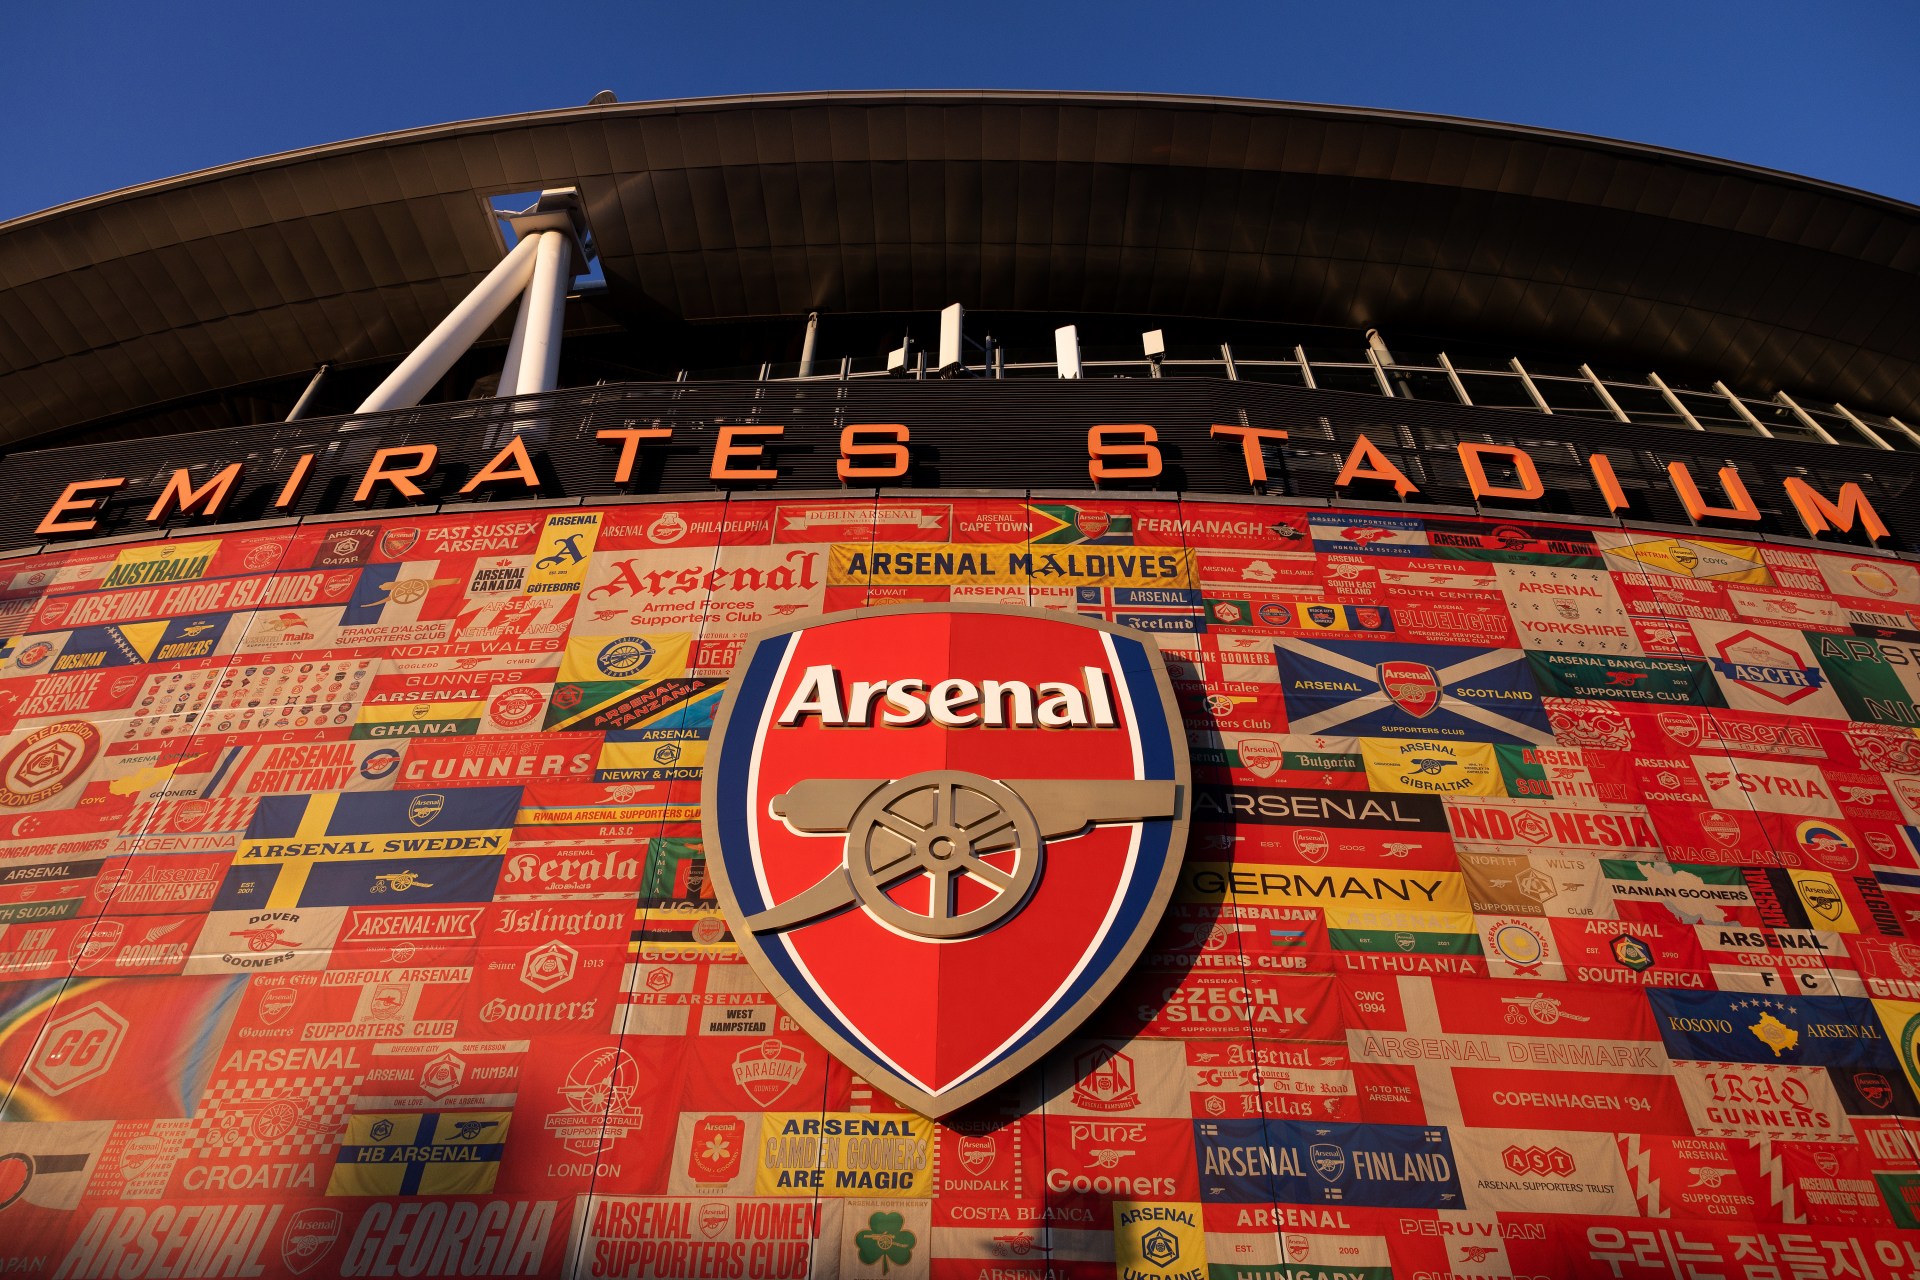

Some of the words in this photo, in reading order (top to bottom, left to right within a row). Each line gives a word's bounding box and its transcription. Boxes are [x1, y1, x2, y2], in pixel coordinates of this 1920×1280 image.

[35, 424, 911, 535] EMIRATES
[1088, 424, 1890, 541] STADIUM
[548, 514, 598, 526] ARSENAL
[976, 514, 1015, 522] ARSENAL
[425, 528, 466, 541] EAST
[472, 522, 539, 538] SUSSEX
[601, 525, 643, 538] ARSENAL
[690, 520, 770, 534] PHILADELPHIA
[1136, 517, 1263, 537] FERMANAGH
[434, 537, 520, 553] ARSENAL
[1433, 532, 1484, 548] ARSENAL
[322, 555, 359, 565] QATAR
[847, 552, 995, 575] ARSENAL
[1009, 553, 1178, 578] MALDIVES
[1327, 554, 1365, 564] ARSENAL
[1408, 561, 1466, 572] AUSTRIA
[1702, 556, 1728, 566] COYG
[1760, 548, 1818, 570] GOONER
[102, 556, 209, 588] AUSTRALIA
[474, 568, 525, 581] ARSENAL
[586, 550, 820, 601] Arsenal
[1202, 565, 1237, 573] ARSENAL
[470, 579, 522, 592] CANADA
[526, 582, 581, 594] GÖTEBORG
[866, 588, 908, 597] KUWAIT
[953, 586, 1026, 597] ARSENAL
[1029, 587, 1074, 597] DELHI
[1518, 582, 1603, 597] ARSENAL
[62, 590, 161, 626] ARSENAL
[158, 582, 229, 616] FAROE
[226, 573, 324, 608] ISLANDS
[1129, 590, 1188, 604] ARSENAL
[641, 601, 696, 613] Armed
[699, 600, 755, 610] Forces
[630, 612, 720, 626] Supporters
[726, 611, 762, 623] Club
[1635, 620, 1689, 630] ARSENAL
[453, 622, 570, 638] NETHERLANDS
[1520, 620, 1630, 637] YORKSHIRE
[334, 633, 412, 645] SUPPORTERS
[416, 632, 446, 641] CLUB
[157, 640, 214, 660] GOONERS
[390, 643, 470, 657] NORTH
[482, 639, 560, 652] WALES
[54, 652, 108, 670] BOSNIAN
[406, 671, 523, 687] GUNNERS
[1385, 669, 1431, 680] Arsenal
[1734, 664, 1808, 687] ASCFR
[29, 670, 106, 697] TÜRKİYE
[1222, 682, 1259, 692] Tralee
[1294, 680, 1362, 691] ARSENAL
[370, 688, 485, 703] ARSENAL
[777, 663, 1114, 728] Arsenal
[1456, 688, 1533, 700] SCOTLAND
[1574, 686, 1654, 699] SUPPORTERS
[1657, 691, 1690, 701] CLUB
[13, 691, 96, 716] ARSENAL
[370, 722, 458, 737] GHANA
[642, 730, 700, 740] ARSENAL
[262, 743, 357, 771] ARSENAL
[1295, 754, 1356, 769] Bulgaria
[1634, 757, 1690, 769] ARSENAL
[405, 753, 592, 780] GUNNERS
[246, 765, 357, 794] BRITTANY
[1734, 772, 1829, 800] SYRIA
[150, 789, 198, 798] GOONERS
[1644, 791, 1709, 803] DONEGAL
[533, 813, 572, 821] RWANDA
[575, 811, 617, 821] ARSENAL
[621, 810, 682, 820] SUPPORTERS
[113, 835, 236, 852] ARGENTINA
[242, 840, 375, 859] ARSENAL
[383, 835, 503, 854] SWEDEN
[1339, 844, 1366, 852] 2002
[504, 850, 640, 883] Kerala
[1470, 855, 1517, 868] NORTH
[1545, 858, 1586, 871] WILTS
[4, 866, 70, 880] ARSENAL
[1192, 871, 1443, 902] GERMANY
[1612, 884, 1677, 897] IRANIAN
[1679, 888, 1748, 901] GOONERS
[18, 904, 69, 919] SUDAN
[249, 912, 300, 925] DOVER
[493, 906, 626, 936] Islington
[1584, 920, 1664, 938] ARSENAL
[1719, 931, 1829, 950] ARSENAL
[114, 943, 188, 968] GOONERS
[222, 951, 296, 968] GOONERS
[1264, 955, 1308, 969] CLUB
[1344, 953, 1476, 974] LITHUANIA
[1737, 953, 1823, 968] CROYDON
[488, 961, 516, 970] Since
[582, 959, 604, 968] 1913
[322, 970, 390, 984] NORFOLK
[399, 968, 470, 982] ARSENAL
[1578, 966, 1637, 986] SOUTH
[1641, 972, 1705, 989] AFRICA
[632, 994, 668, 1005] THE
[676, 994, 766, 1005] ARSENAL
[1354, 990, 1385, 1001] CWC
[304, 1022, 406, 1039] SUPPORTERS
[412, 1022, 455, 1036] CLUB
[710, 1022, 767, 1032] HAMPSTEAD
[1668, 1016, 1733, 1035] KOSOVO
[1807, 1023, 1881, 1039] ARSENAL
[220, 1046, 361, 1072] ARSENAL
[1226, 1044, 1312, 1067] Arsenal
[1363, 1036, 1500, 1062] ARSENAL
[1506, 1041, 1658, 1068] DENMARK
[365, 1069, 415, 1082] ARSENAL
[470, 1066, 519, 1080] MUMBAI
[548, 1116, 589, 1126] ARSENAL
[591, 1116, 640, 1126] FOOTBALL
[1706, 1106, 1831, 1129] GUNNERS
[704, 1122, 736, 1132] Arsenal
[781, 1119, 916, 1137] ARSENAL
[765, 1136, 840, 1169] CAMDEN
[846, 1137, 927, 1171] GOONERS
[1672, 1139, 1727, 1152] MIZORAM
[356, 1147, 386, 1162] HB
[389, 1146, 482, 1162] ARSENAL
[548, 1163, 621, 1178] LONDON
[1204, 1146, 1307, 1178] ARSENAL
[1352, 1151, 1451, 1183] FINLAND
[182, 1162, 315, 1191] CROATIA
[776, 1170, 825, 1188] ARE
[835, 1171, 914, 1190] MAGIC
[1047, 1169, 1176, 1196] Gooners
[944, 1180, 1009, 1191] DUNDALK
[1477, 1180, 1522, 1191] ARSENAL
[1585, 1183, 1615, 1194] TRUST
[1681, 1192, 1755, 1206] SUPPORTERS
[1120, 1207, 1197, 1228] ARSENAL
[1707, 1204, 1739, 1216] CLUB
[591, 1201, 692, 1239] ARSENAL
[734, 1202, 822, 1240] WOMEN
[1237, 1208, 1351, 1229] ARSENAL
[1400, 1218, 1547, 1241] PERUVIAN
[51, 1204, 284, 1280] ARSENAL
[339, 1200, 560, 1277] GEORGIA
[1235, 1244, 1254, 1253] EST.
[1339, 1247, 1360, 1255] 2009
[592, 1241, 747, 1279] SUPPORTERS
[749, 1241, 810, 1279] CLUB
